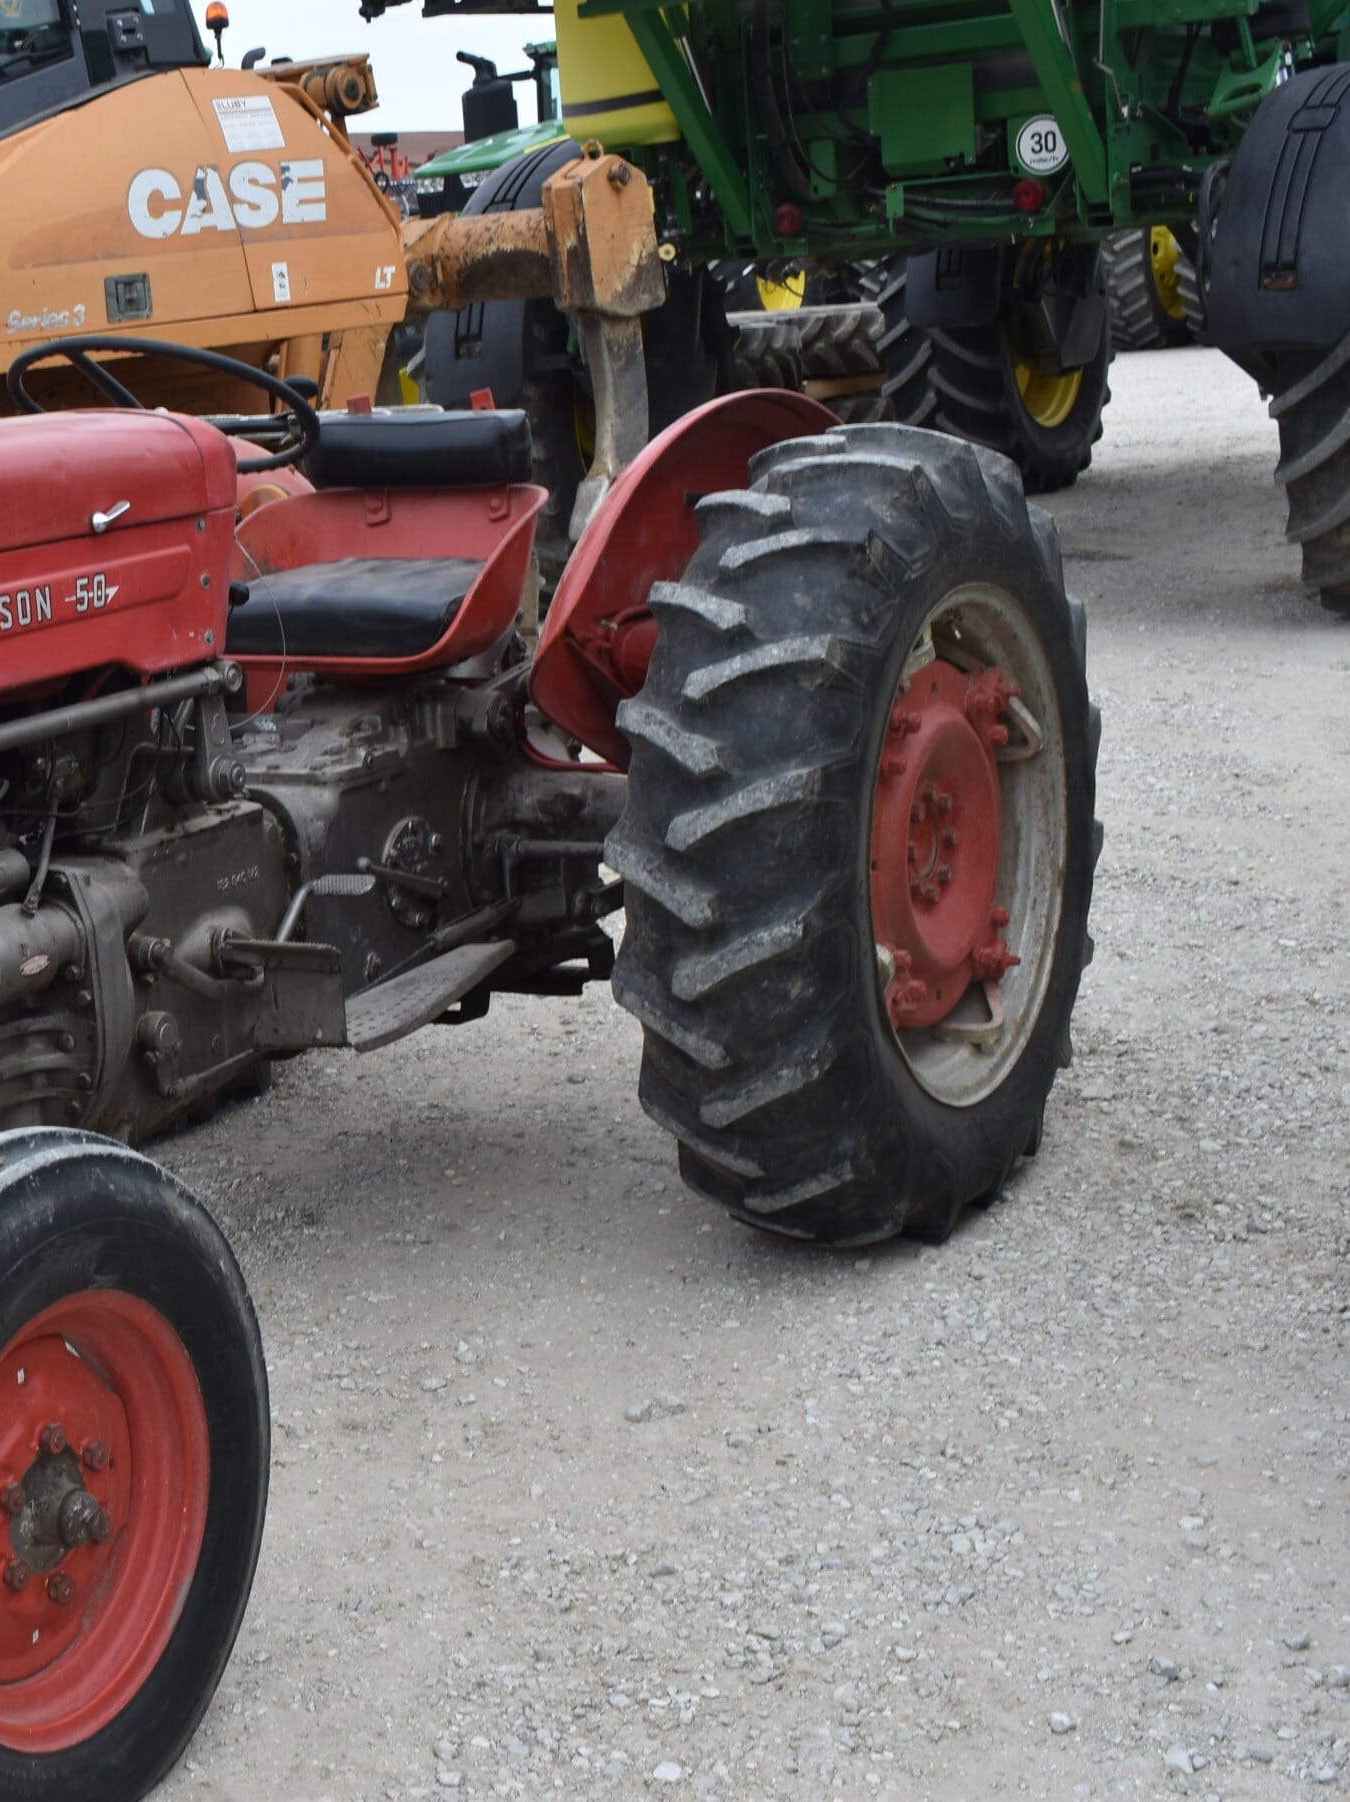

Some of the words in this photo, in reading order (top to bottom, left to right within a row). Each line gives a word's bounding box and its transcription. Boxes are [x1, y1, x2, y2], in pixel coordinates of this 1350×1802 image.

[1030, 130, 1056, 154] 30
[128, 159, 327, 239] CASE
[374, 264, 396, 290] LT
